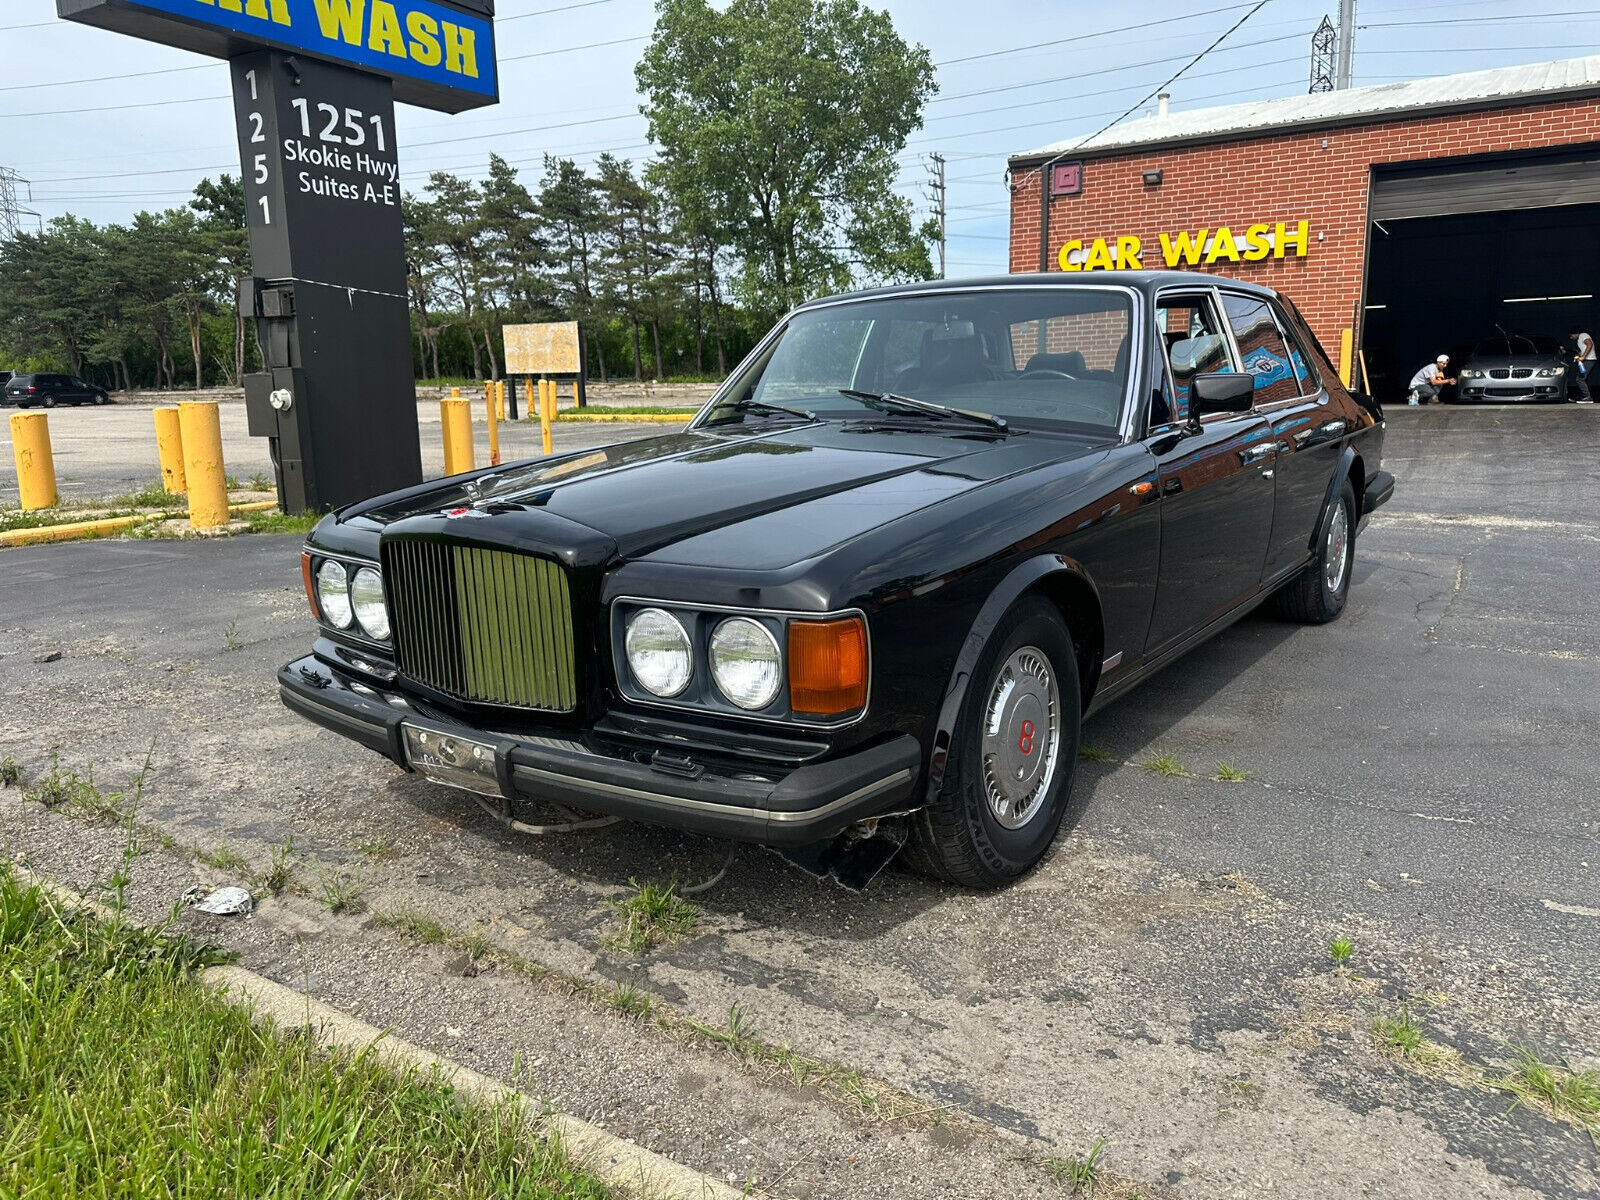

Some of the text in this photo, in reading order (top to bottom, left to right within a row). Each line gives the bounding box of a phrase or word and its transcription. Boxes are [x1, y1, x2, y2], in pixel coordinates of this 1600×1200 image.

[312, 0, 479, 78] WASH
[291, 97, 386, 152] 1251
[284, 138, 352, 171] Skokie
[299, 171, 395, 206] Suites A-E
[1058, 220, 1309, 272] CAR WASH
